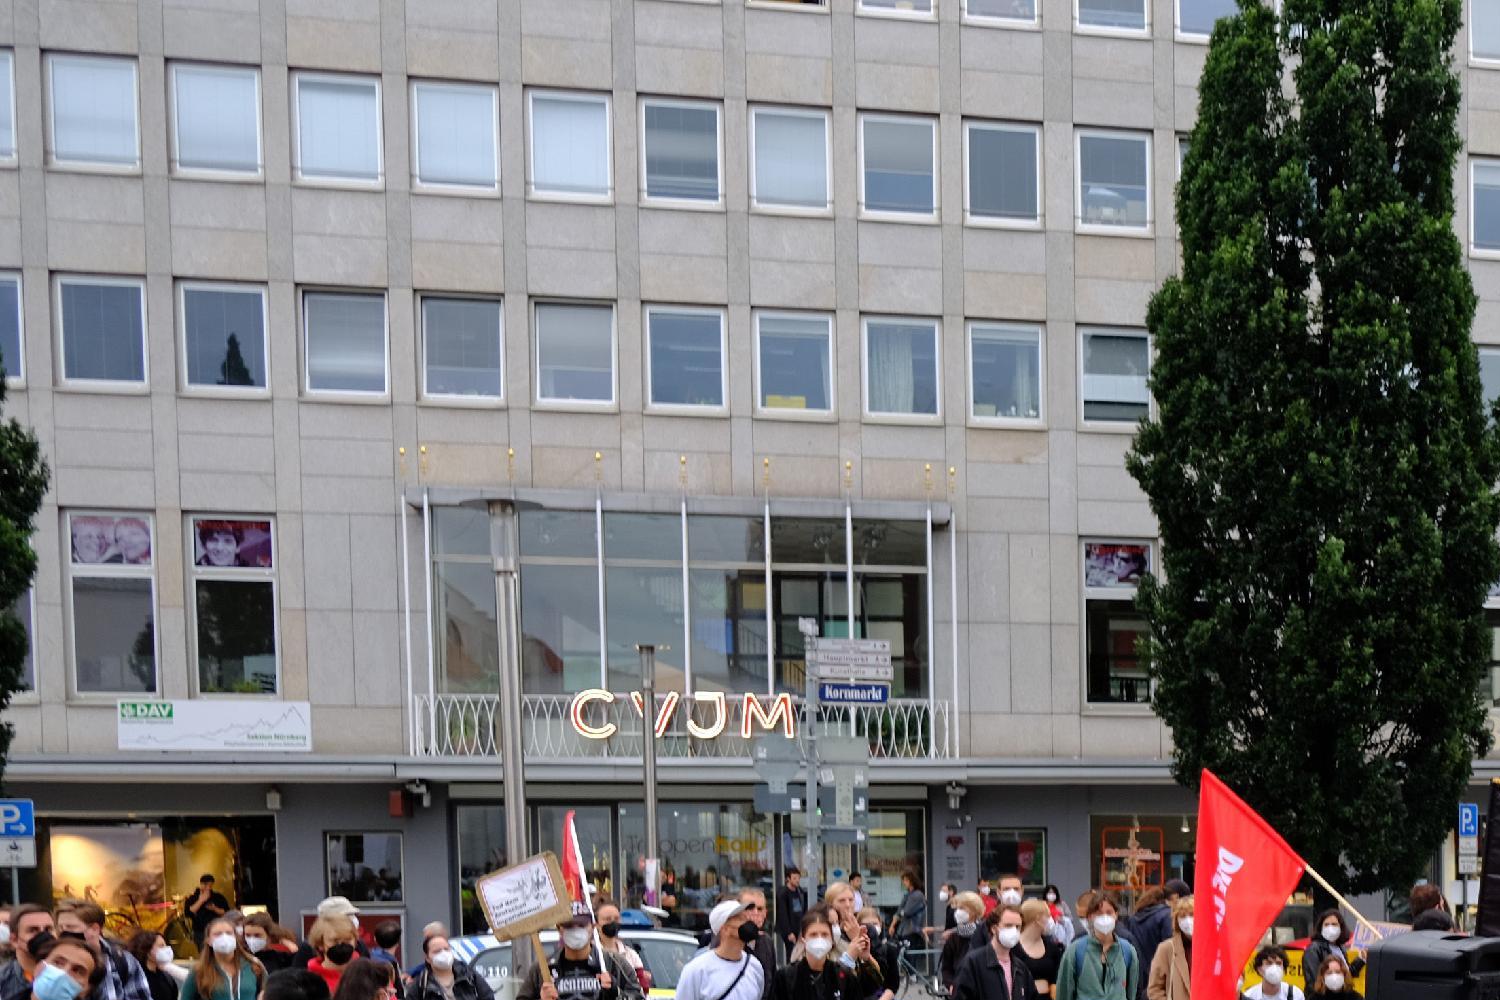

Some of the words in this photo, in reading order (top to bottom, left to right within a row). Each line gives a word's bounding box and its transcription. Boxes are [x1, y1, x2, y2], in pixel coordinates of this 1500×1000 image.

[825, 684, 882, 701] Kornmarkt
[135, 703, 171, 719] DAV
[570, 688, 796, 739] CVJM
[0, 804, 21, 834] P
[489, 966, 507, 978] 110
